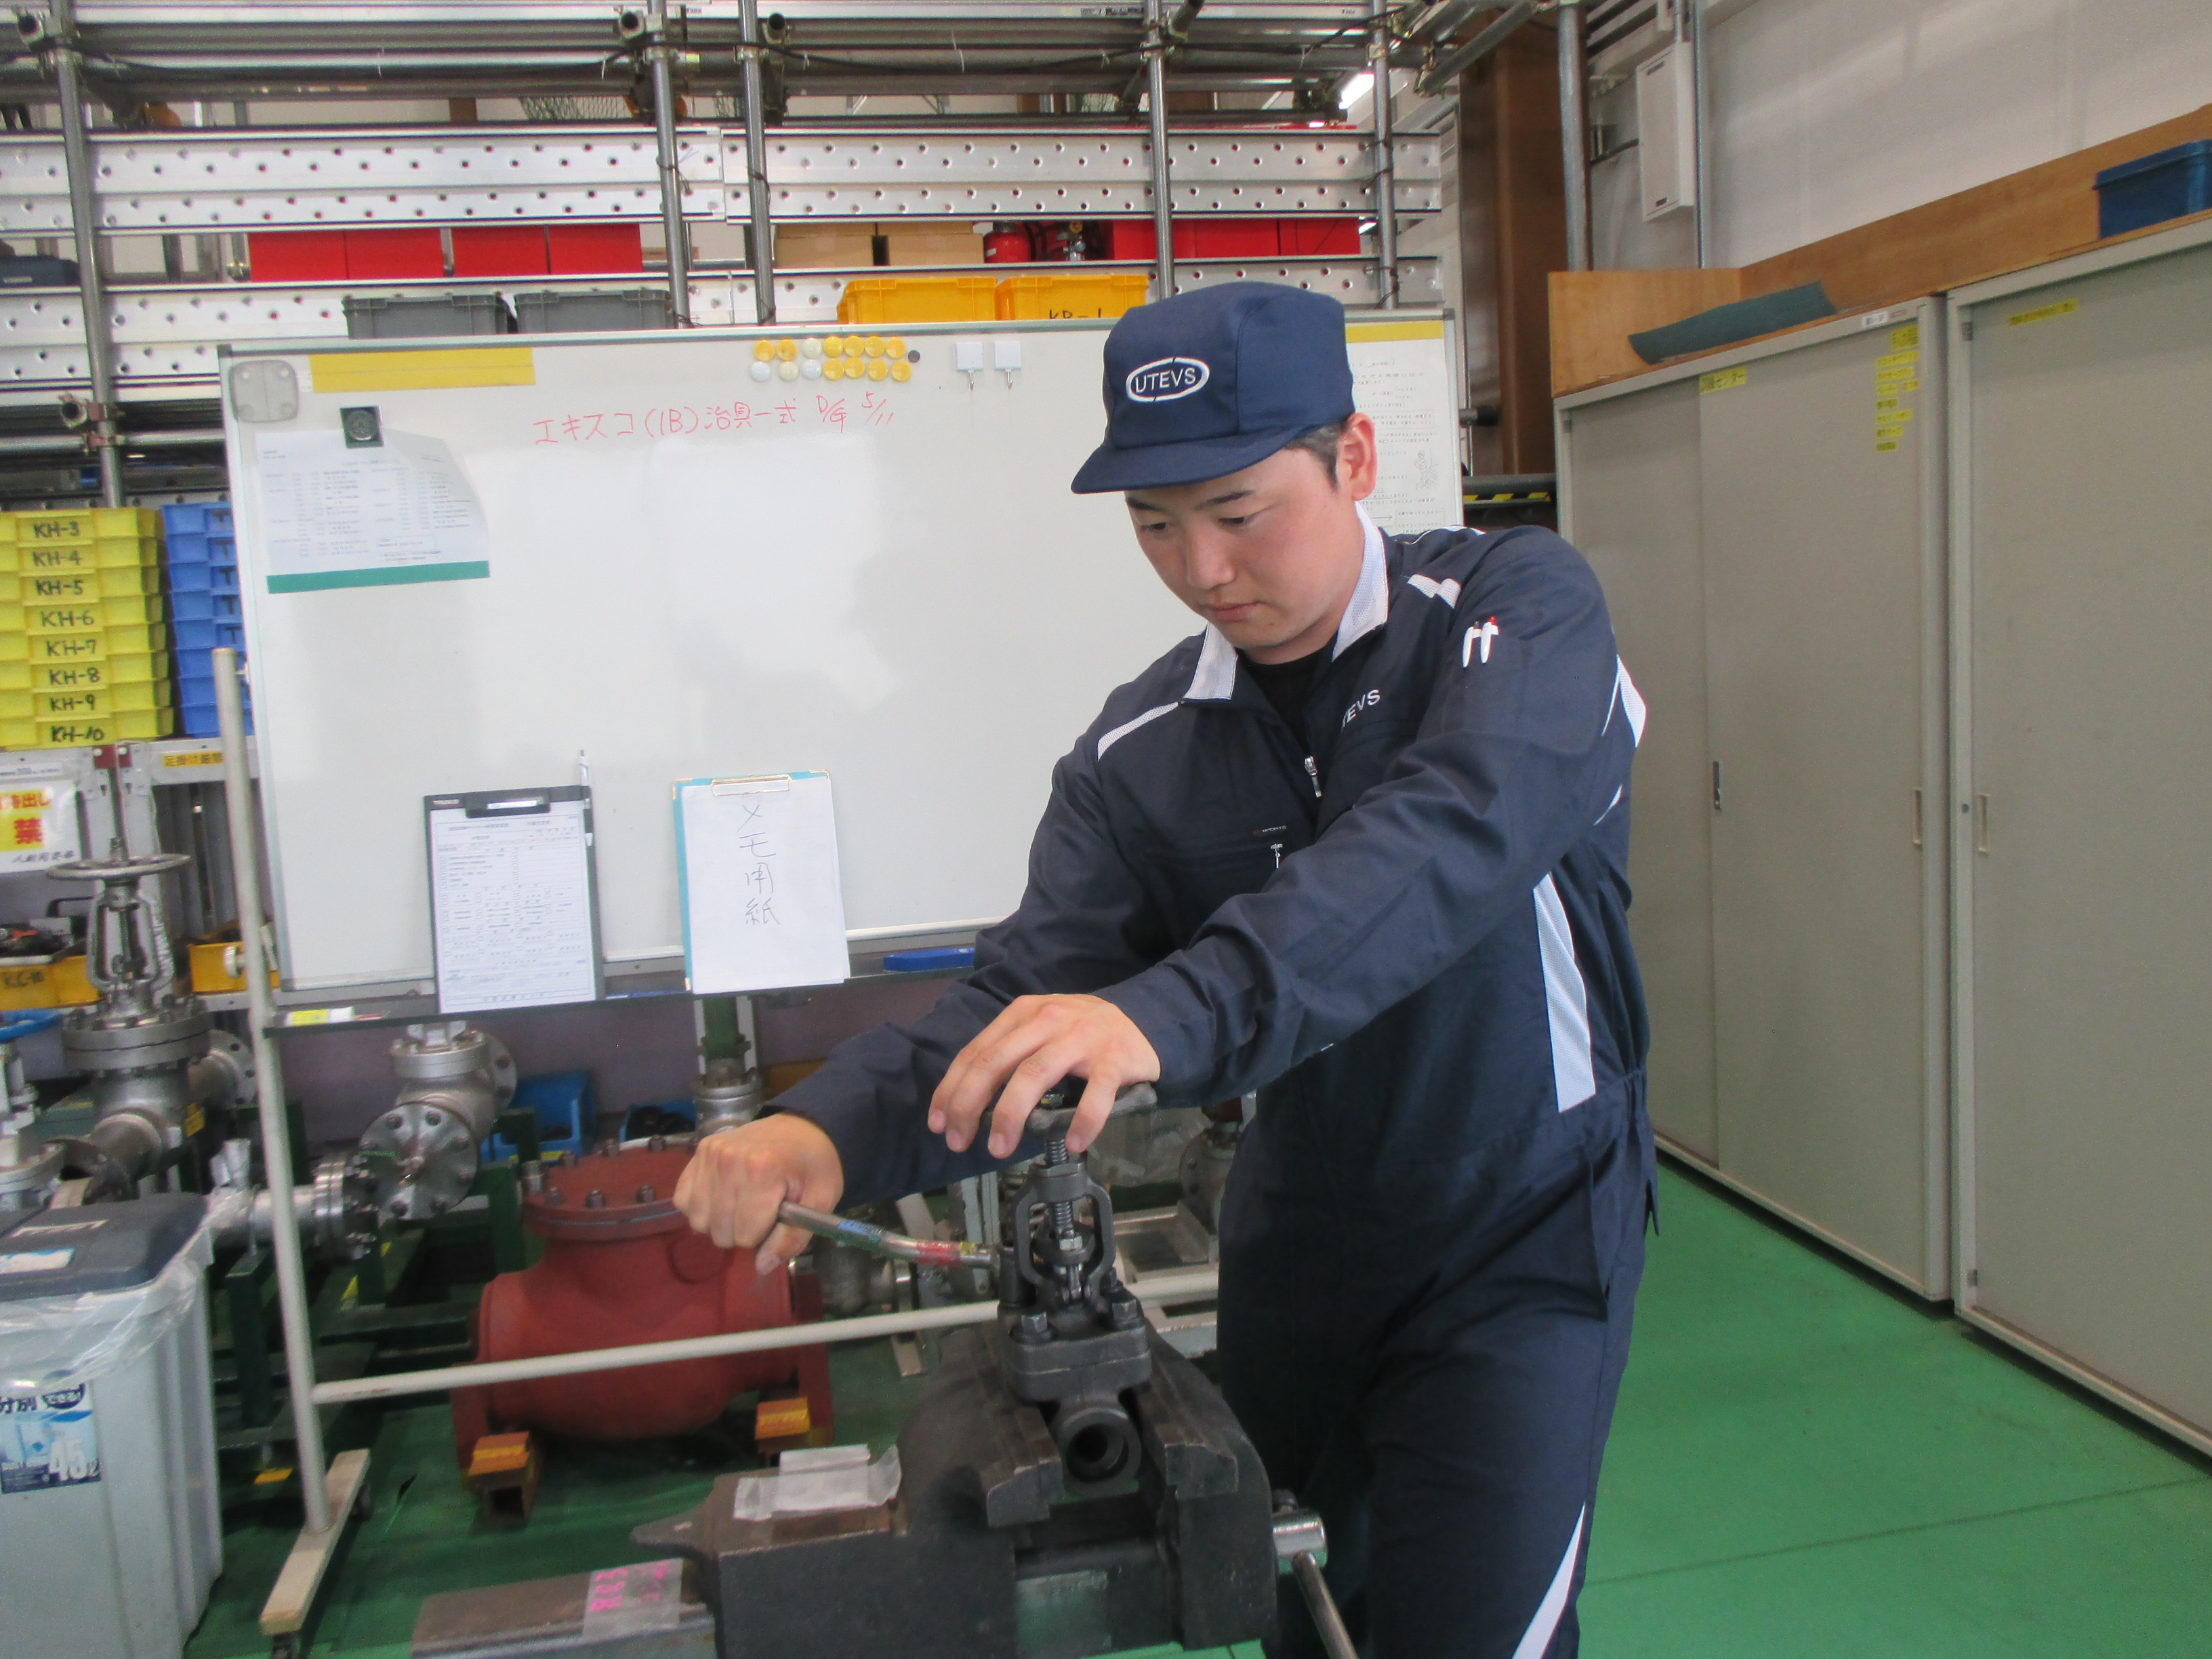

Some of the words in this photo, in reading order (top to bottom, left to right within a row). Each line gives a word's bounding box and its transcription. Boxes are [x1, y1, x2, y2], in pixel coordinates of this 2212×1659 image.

[1134, 367, 1197, 394] UTEVS
[33, 520, 80, 538] KH-3
[33, 550, 83, 567] KH-4
[35, 579, 85, 596] KH-5
[41, 610, 95, 627] KH-6
[46, 639, 97, 657] KH-7
[49, 667, 101, 686] KH-8
[49, 693, 96, 712] KH-9
[51, 726, 105, 742] KH-10
[735, 804, 781, 926] メモ用紙
